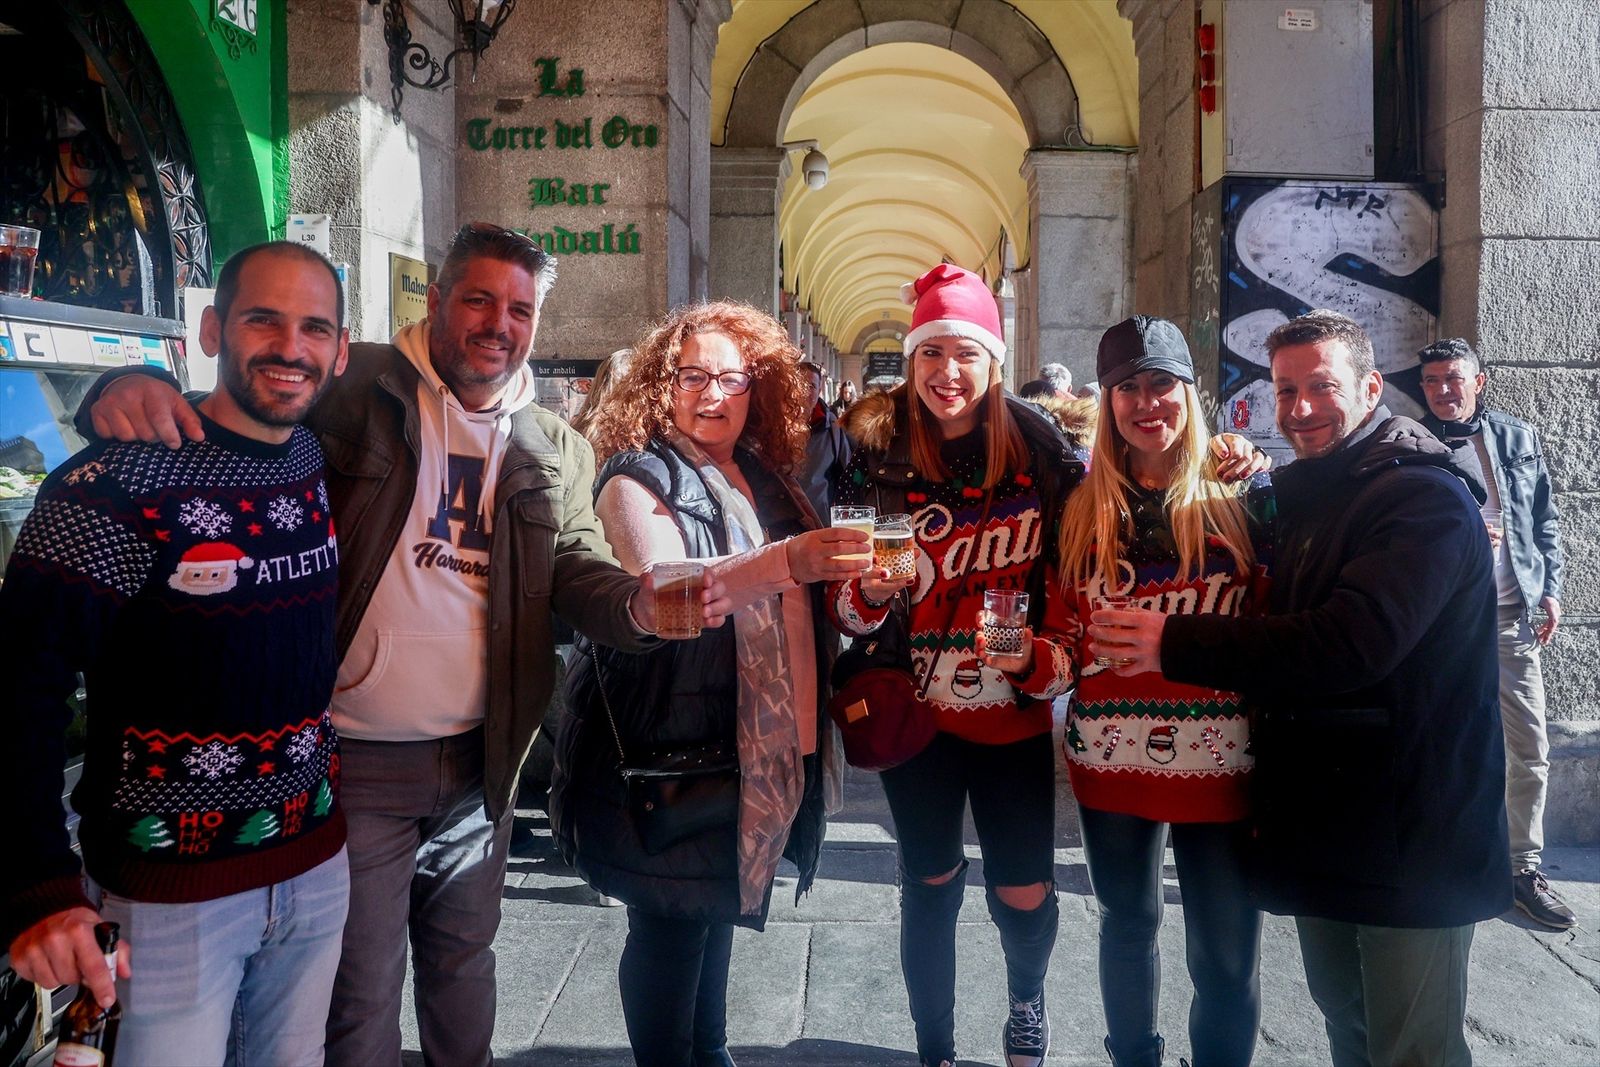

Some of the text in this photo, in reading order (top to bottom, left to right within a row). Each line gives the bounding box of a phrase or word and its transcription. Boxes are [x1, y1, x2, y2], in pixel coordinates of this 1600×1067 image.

[534, 56, 586, 98] La
[466, 115, 658, 150] Torre del Oro
[528, 177, 610, 210] Bar
[301, 234, 316, 242] L30
[512, 223, 640, 255] ndalú
[99, 343, 120, 355] VISA
[538, 365, 576, 375] bar andalú
[425, 454, 490, 553] A
[255, 544, 331, 585] ATLETI
[285, 791, 309, 814] HO
[179, 811, 224, 828] HO
